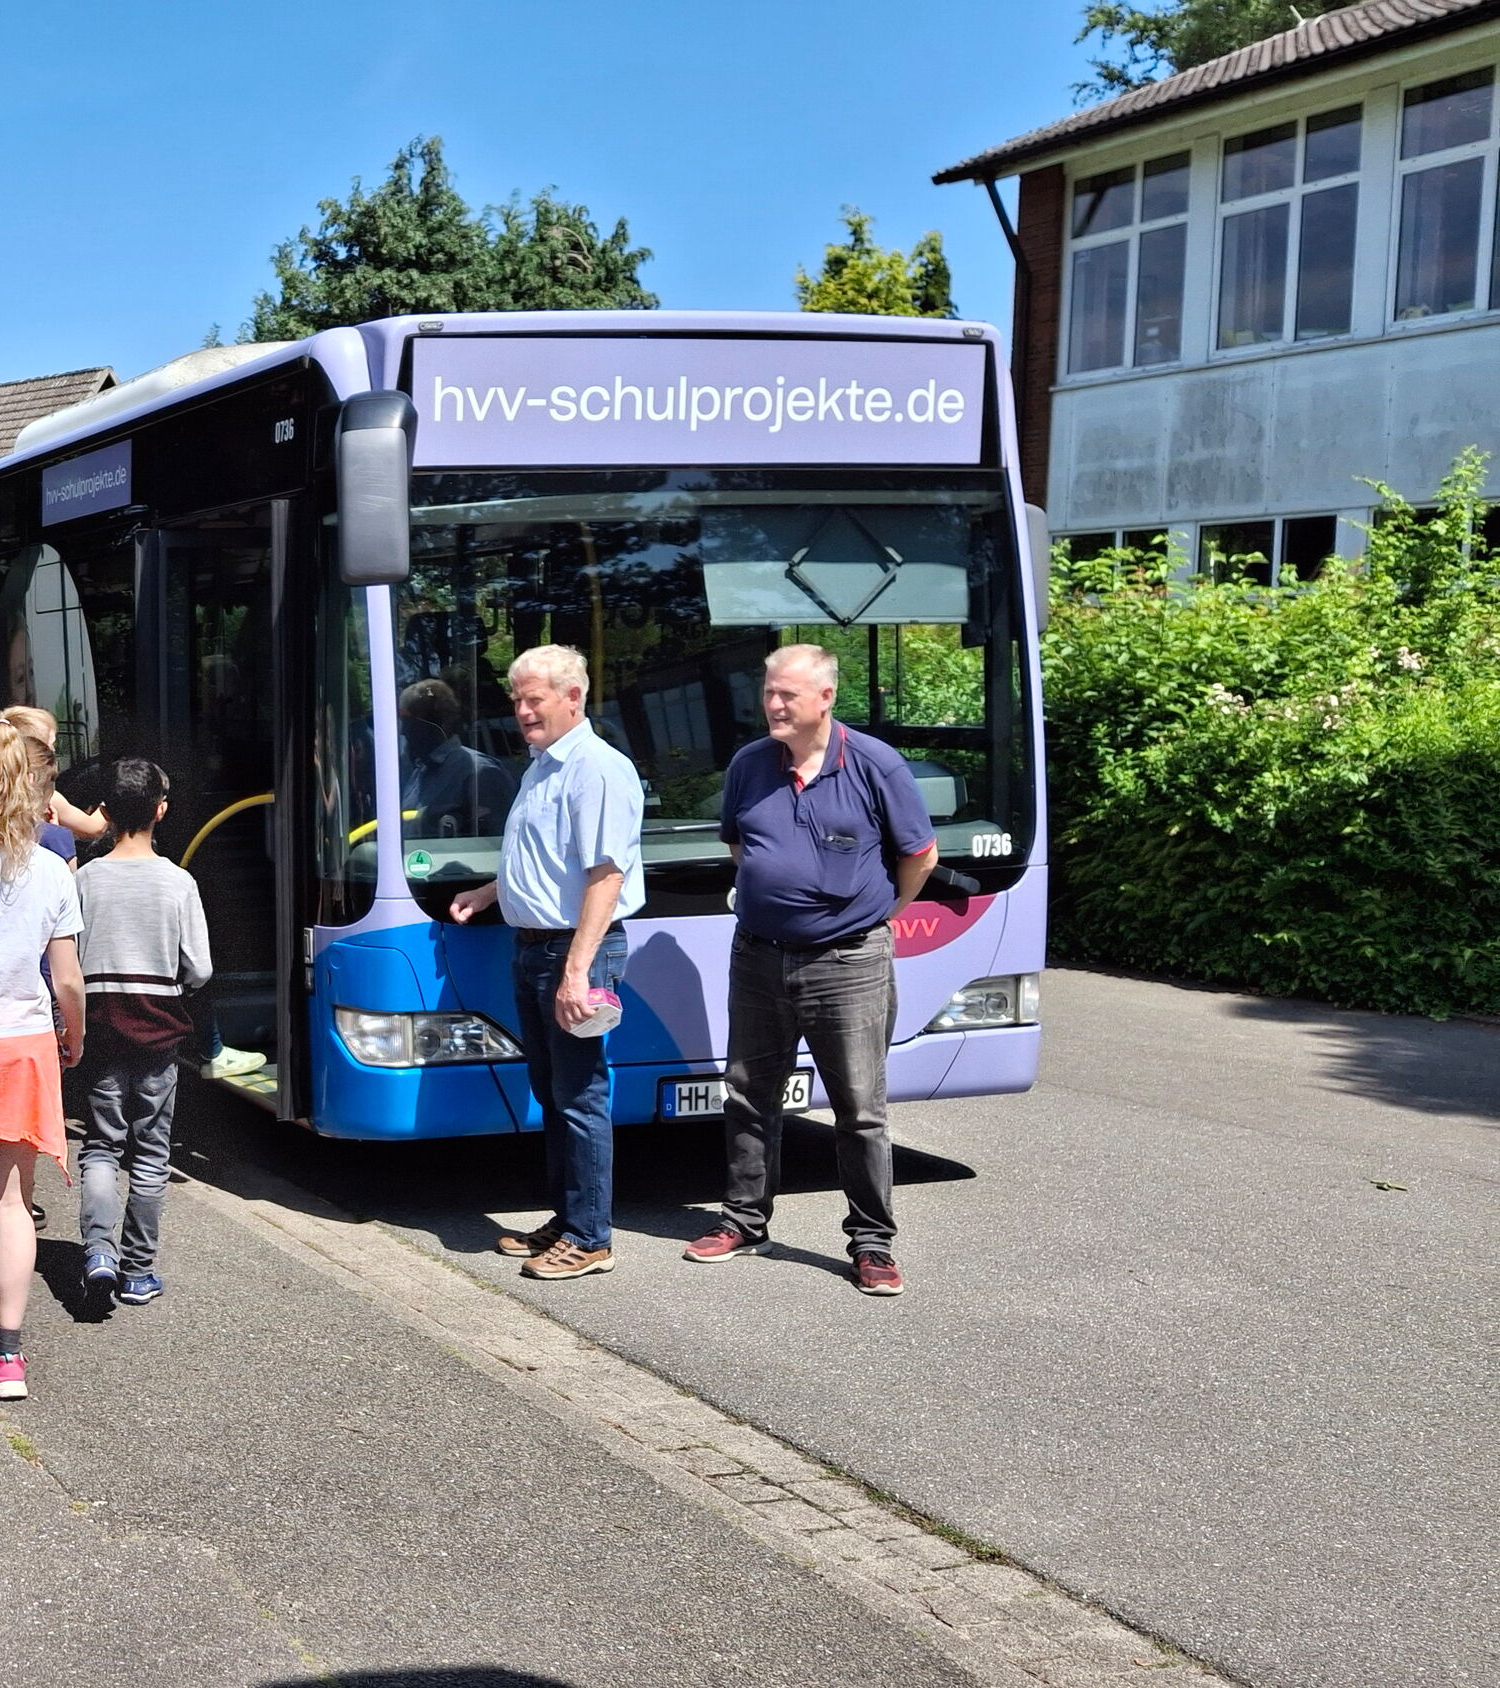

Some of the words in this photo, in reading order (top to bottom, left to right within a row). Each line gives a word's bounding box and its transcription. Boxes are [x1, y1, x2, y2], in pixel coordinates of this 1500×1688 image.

[434, 376, 965, 433] hvv-schulprojekte.de
[275, 418, 295, 444] 0736
[45, 465, 127, 506] hvv-schulprojekte.de
[416, 852, 424, 865] 4
[972, 833, 1012, 858] 0736
[678, 1085, 709, 1112] HH
